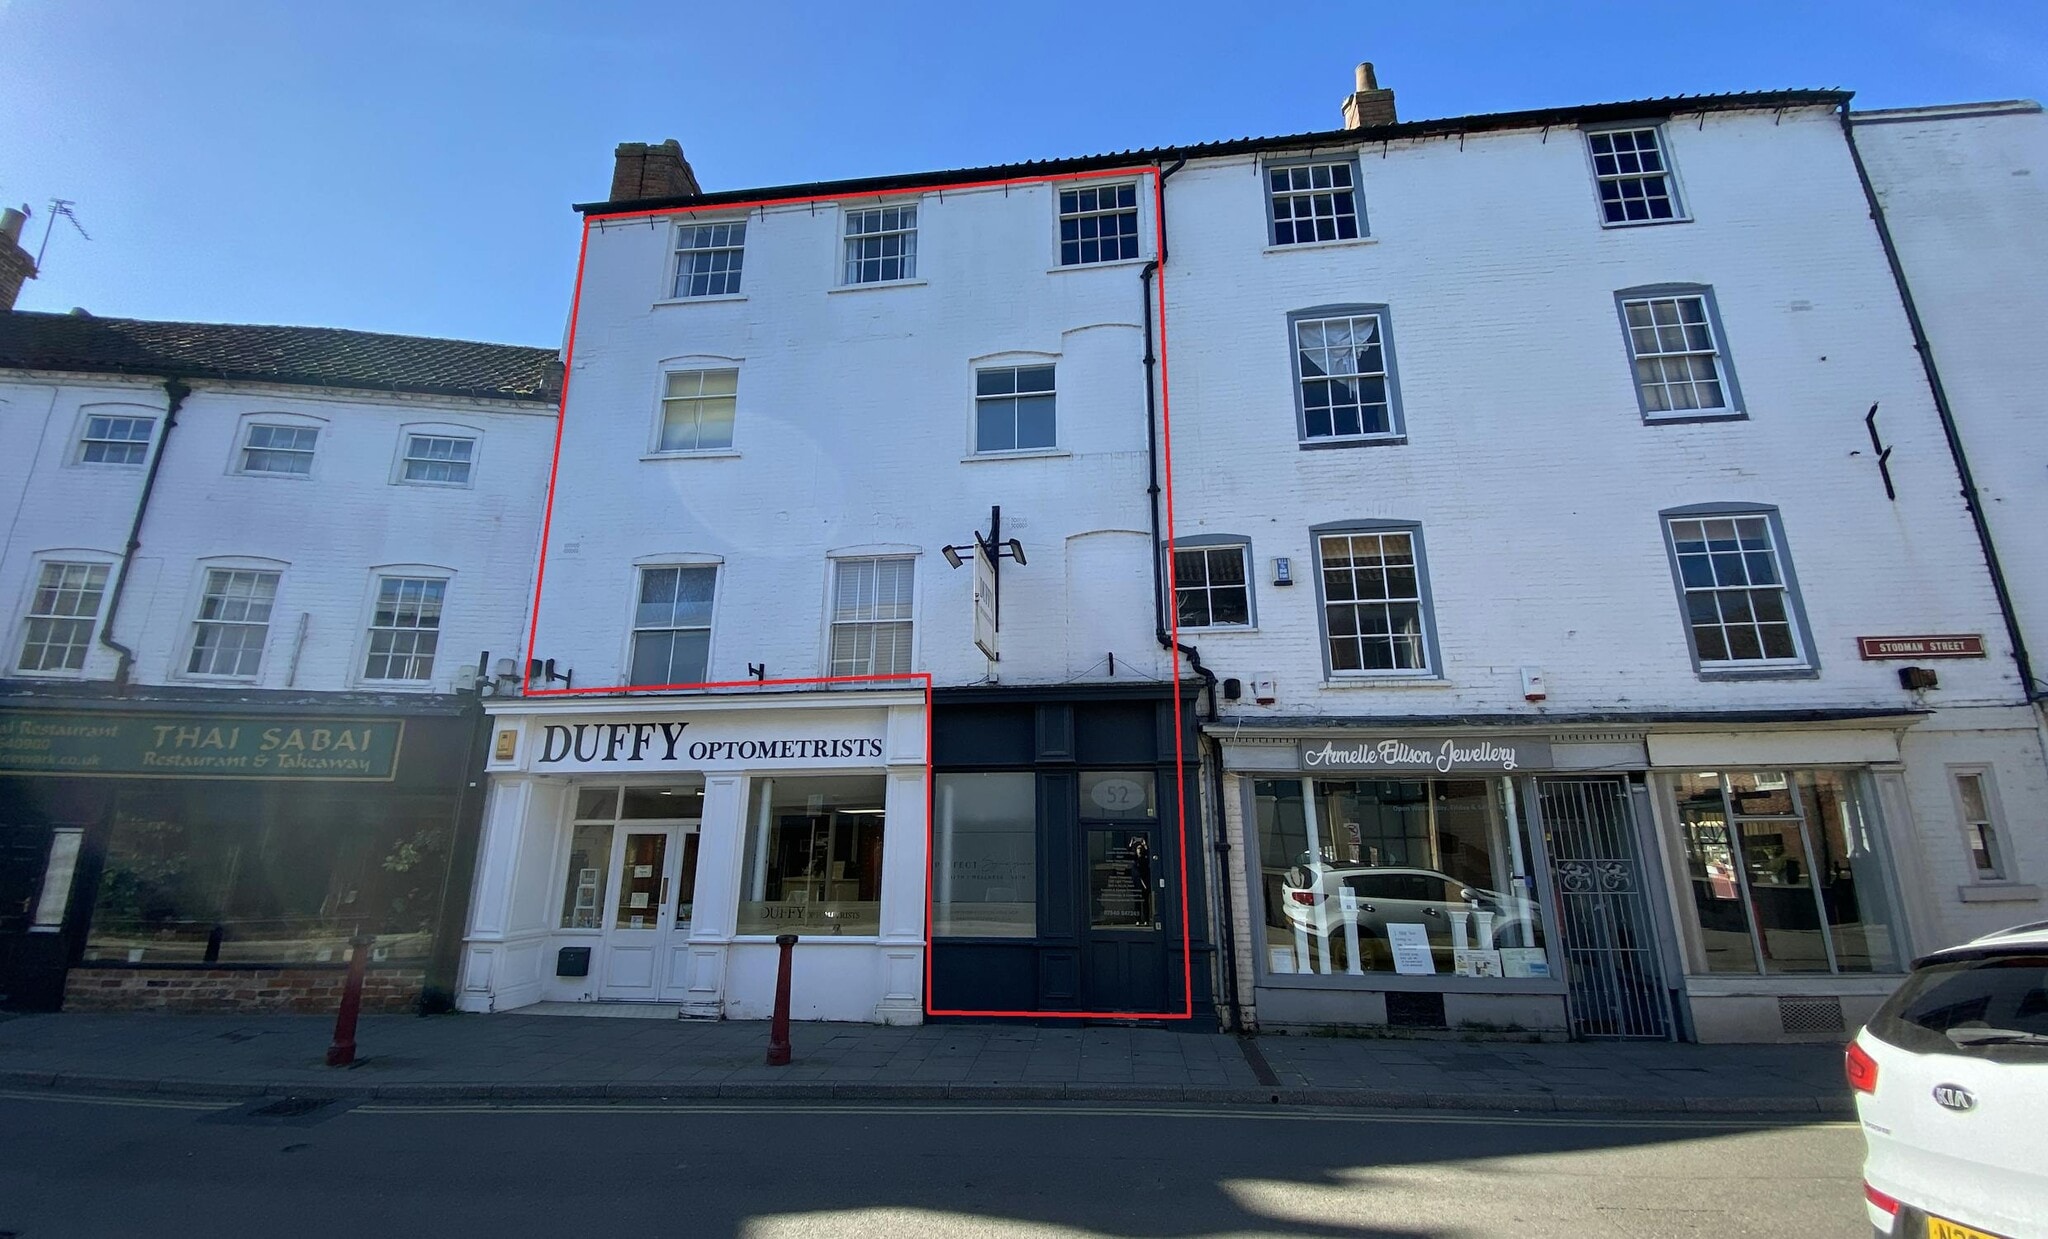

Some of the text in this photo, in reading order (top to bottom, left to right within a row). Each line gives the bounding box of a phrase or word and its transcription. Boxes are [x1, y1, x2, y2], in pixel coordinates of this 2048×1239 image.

[1880, 641, 1965, 652] STODMAN STREET
[20, 721, 119, 737] Restaurant
[153, 725, 372, 752] THAI SABAI
[538, 721, 883, 763] DUFFY OPTOMETRISTS
[142, 751, 371, 772] Restaurant & Takeaway
[1305, 738, 1519, 773] Armelle Ellison Jewellery
[1107, 786, 1129, 803] 52
[1935, 1087, 1969, 1108] KIA
